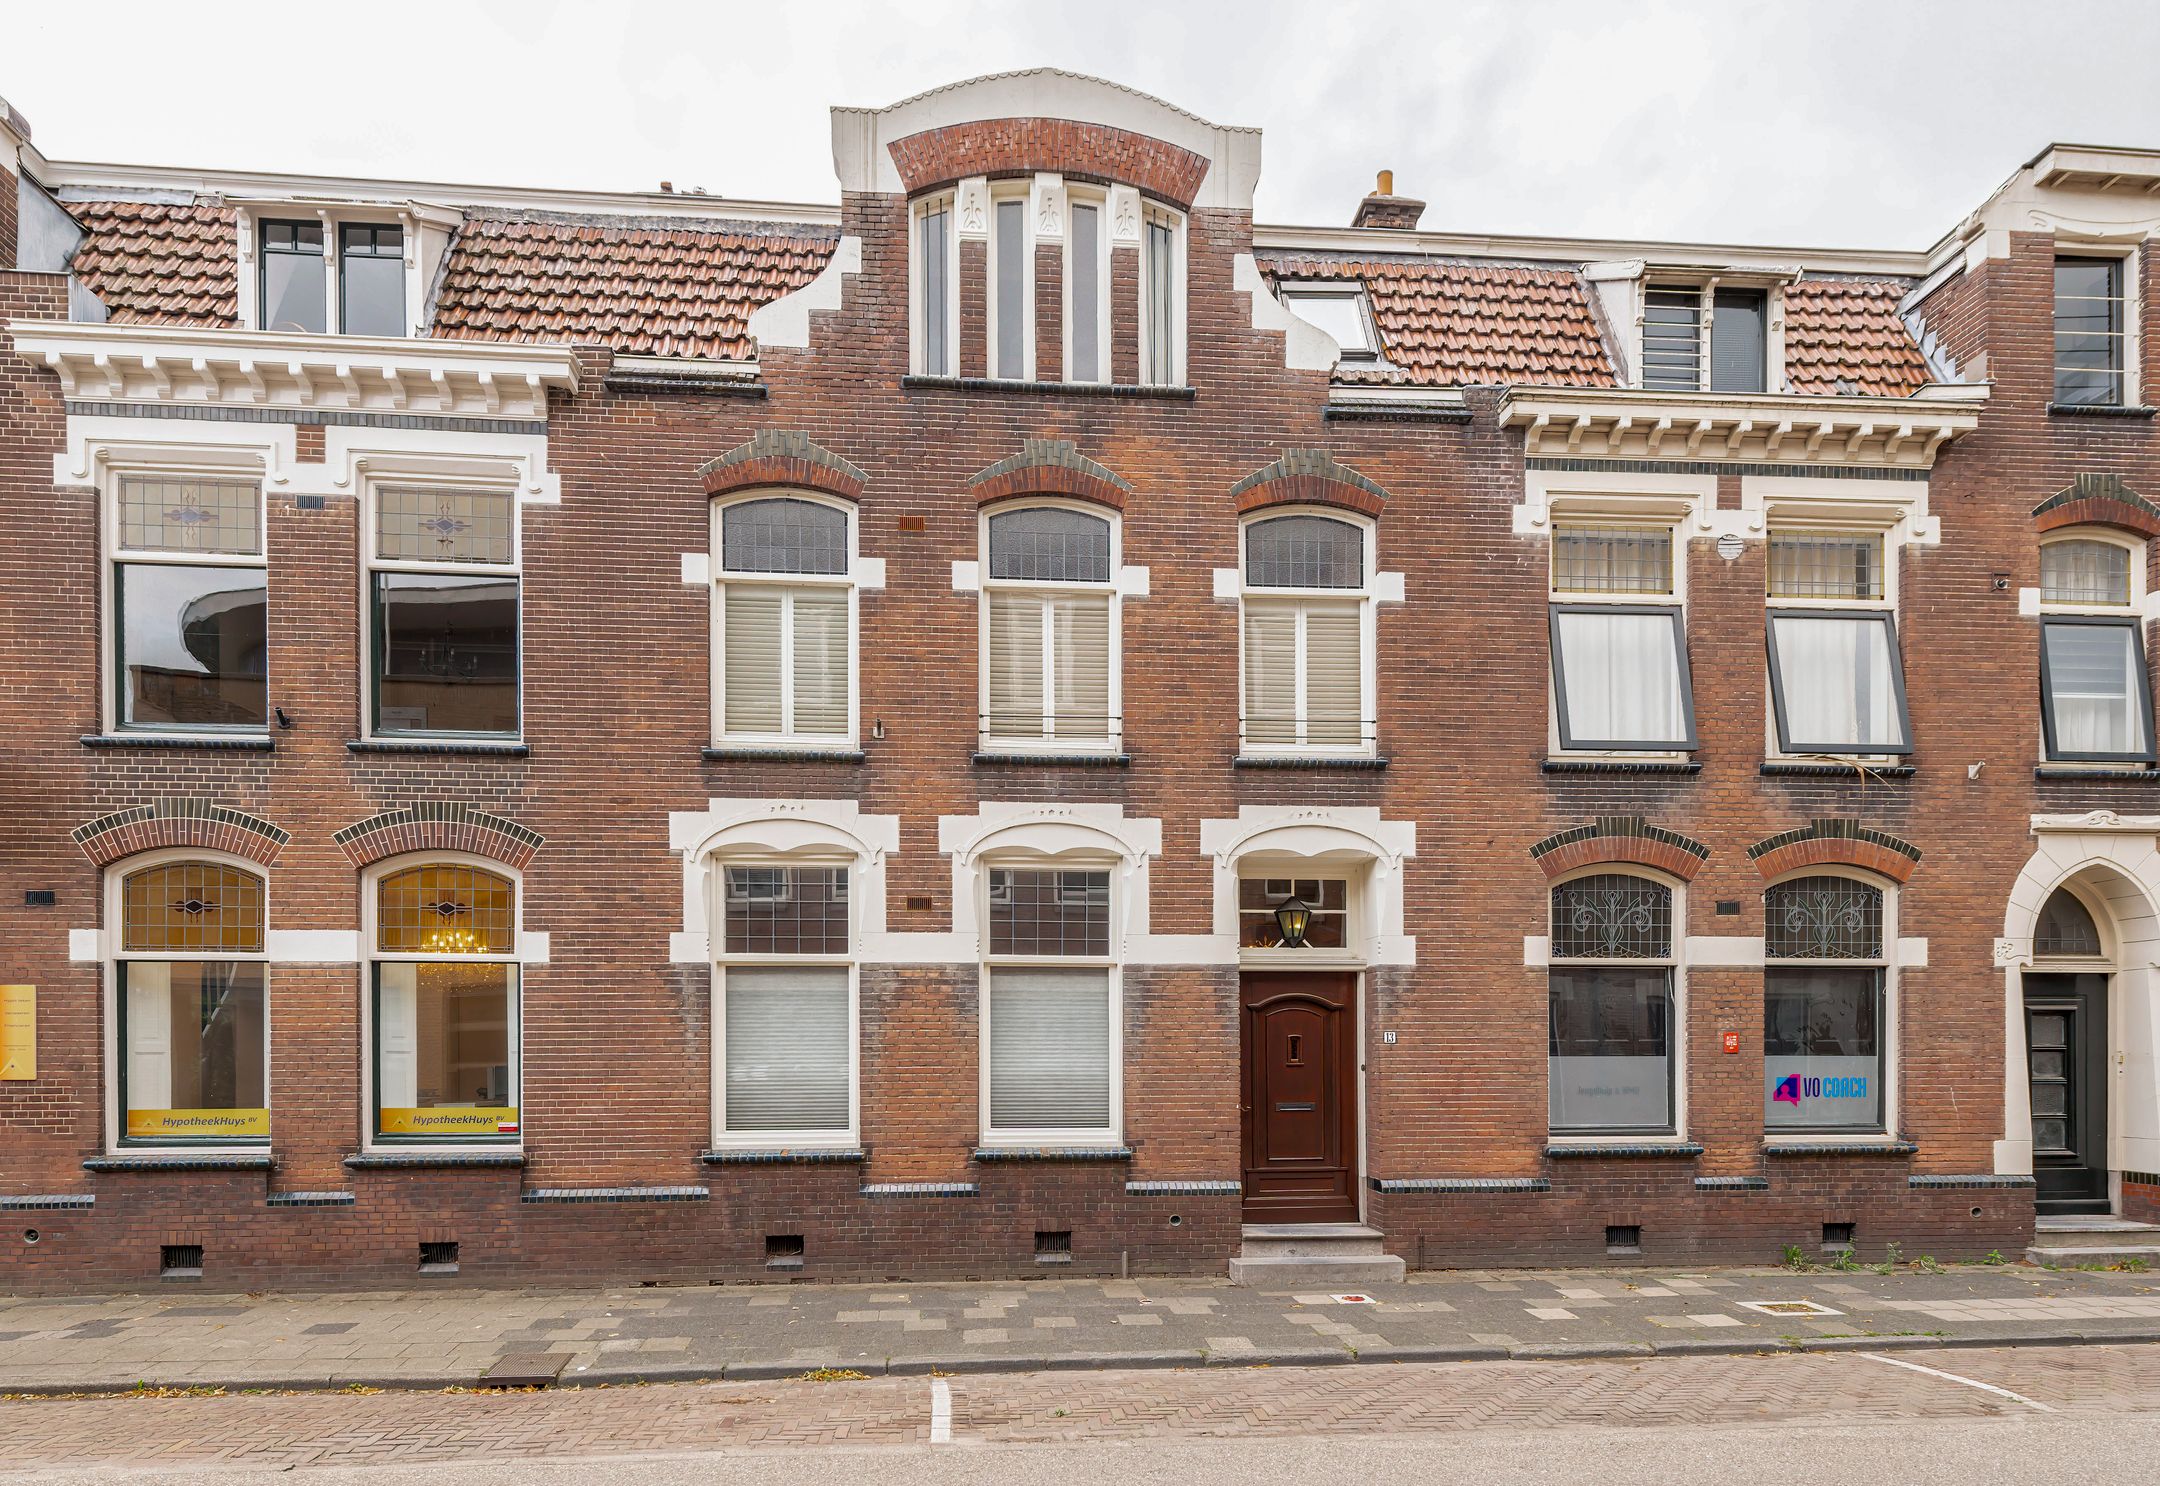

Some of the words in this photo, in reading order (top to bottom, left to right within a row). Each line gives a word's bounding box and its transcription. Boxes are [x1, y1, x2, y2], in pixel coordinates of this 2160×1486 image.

[1386, 1032, 1394, 1043] 13
[1803, 1077, 1820, 1098] VO
[1823, 1077, 1867, 1098] COACH
[162, 1116, 246, 1127] HypotheekHuys
[413, 1115, 493, 1125] HypotheekHuys
